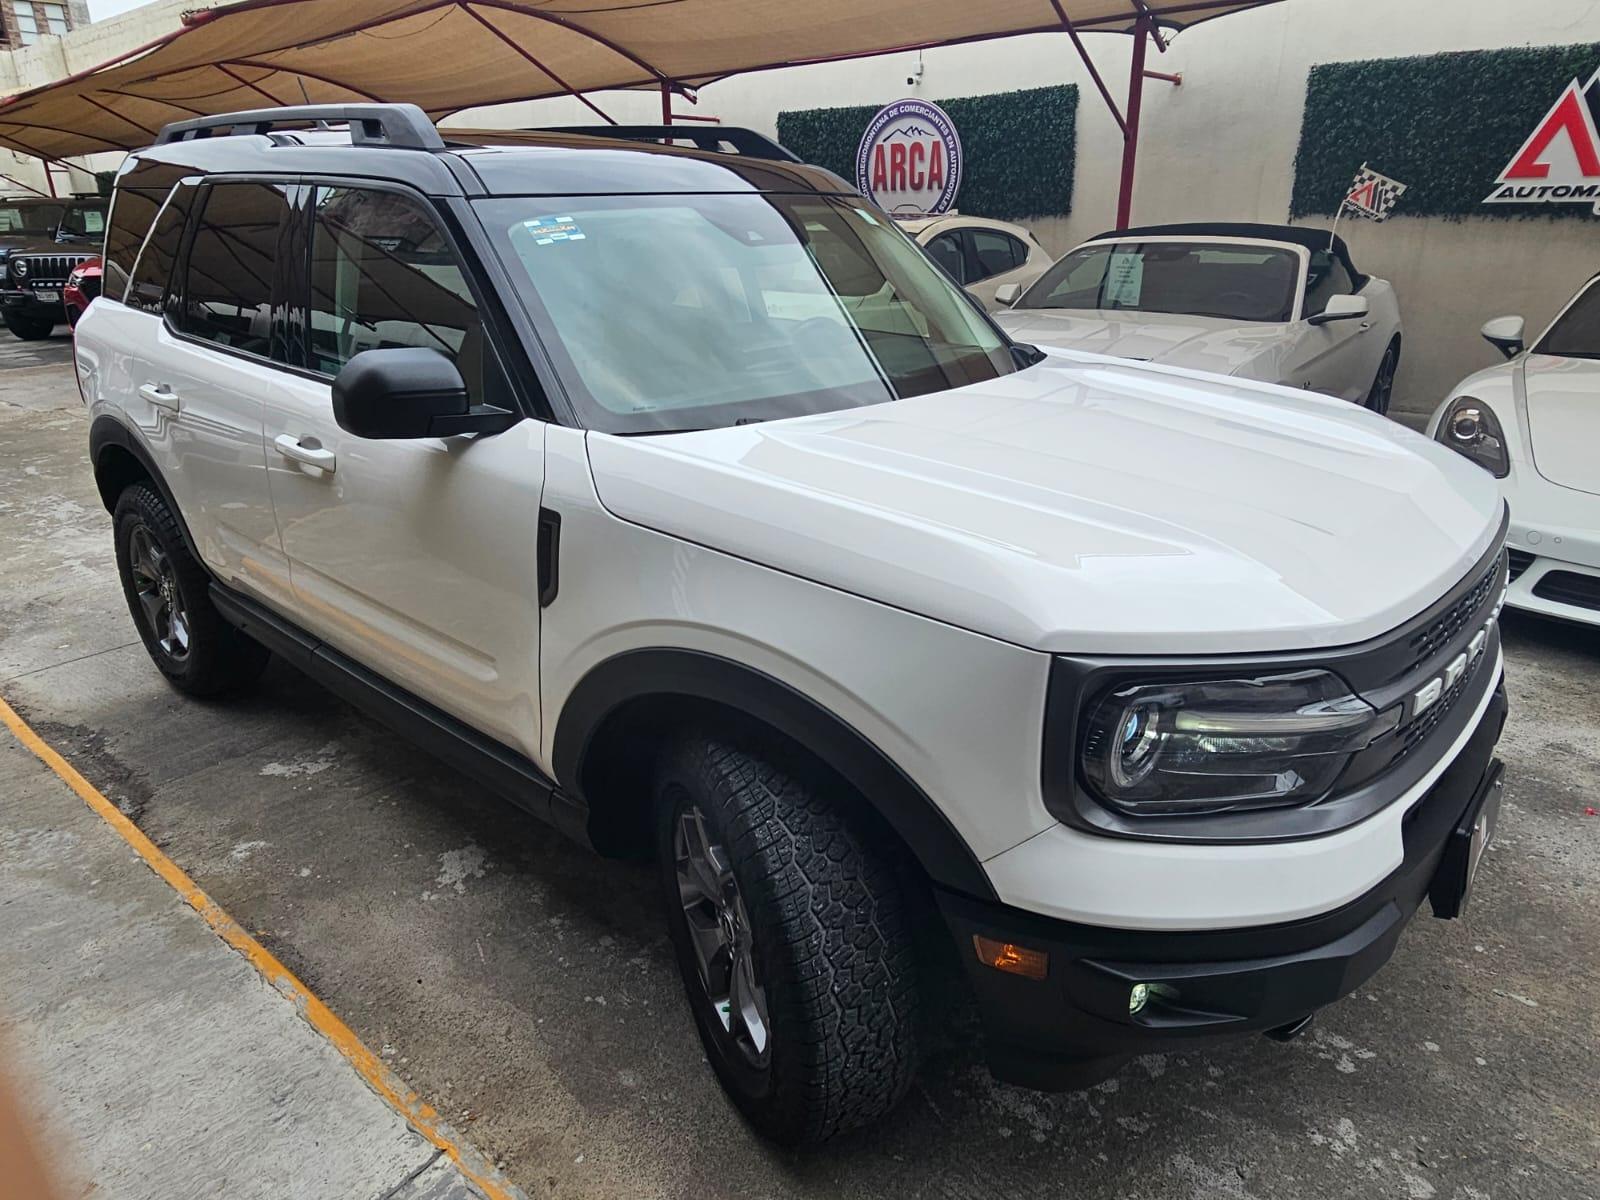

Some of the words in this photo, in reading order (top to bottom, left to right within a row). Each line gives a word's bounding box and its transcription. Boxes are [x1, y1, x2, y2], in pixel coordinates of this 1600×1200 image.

[889, 107, 900, 118] DE
[899, 105, 950, 136] COMERCIANTES
[946, 135, 955, 149] EN
[872, 140, 944, 192] ARCA
[938, 150, 957, 211] AUTOMOVILES
[1495, 184, 1600, 199] AUTOM
